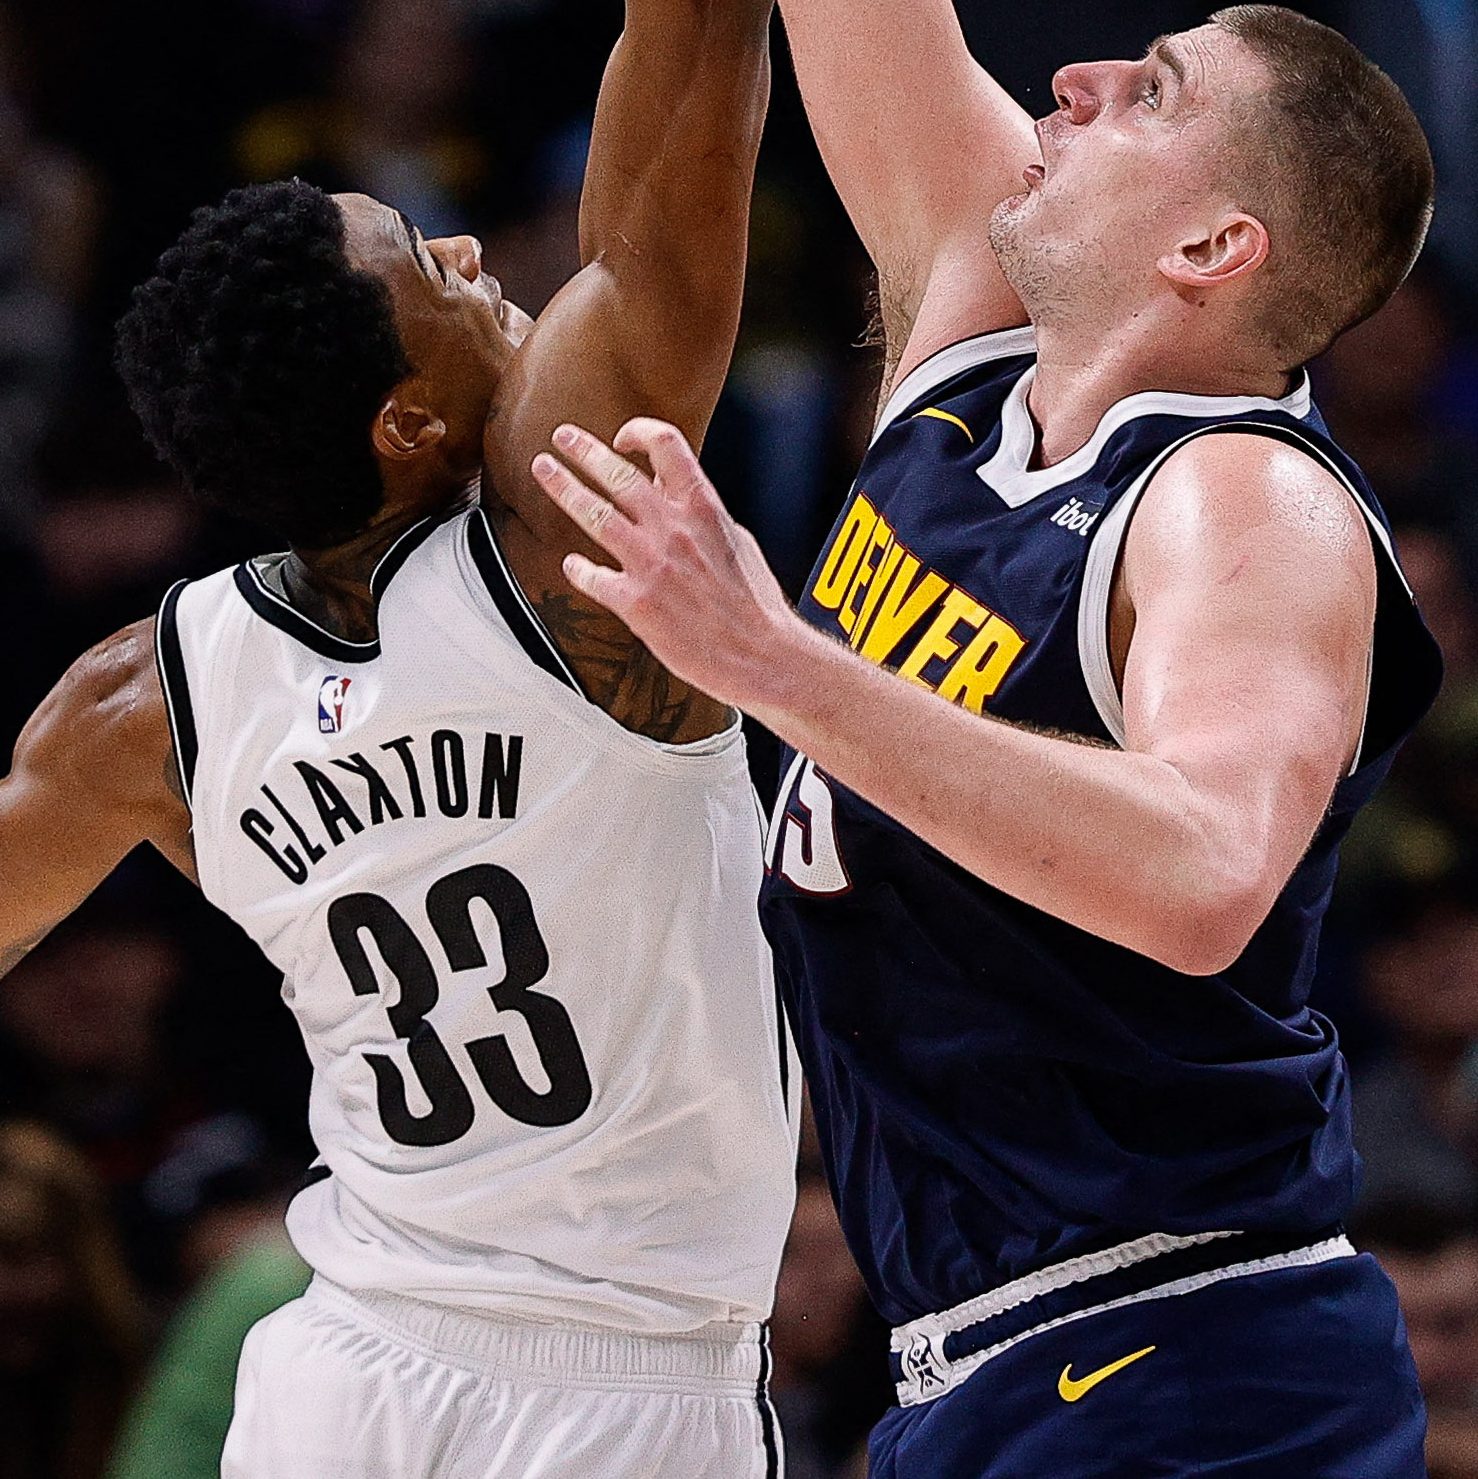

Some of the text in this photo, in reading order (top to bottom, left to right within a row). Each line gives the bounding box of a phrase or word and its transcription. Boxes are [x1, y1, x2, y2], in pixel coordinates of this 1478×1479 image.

[812, 489, 1030, 715] DENVER
[241, 732, 524, 885] CLAXTON
[326, 862, 593, 1148] 33
